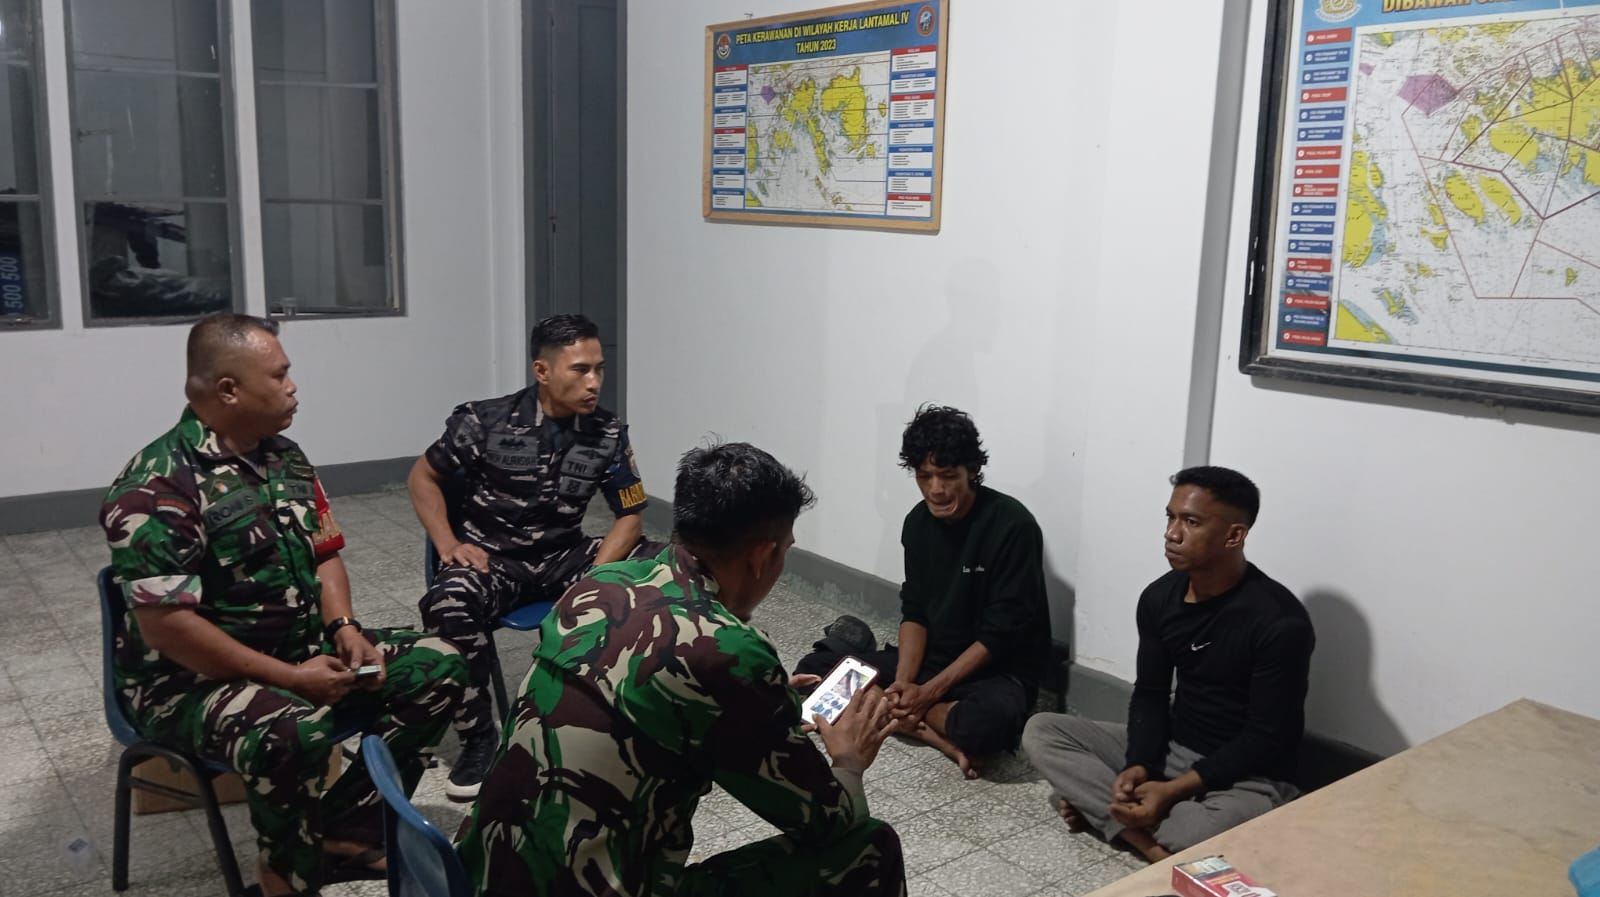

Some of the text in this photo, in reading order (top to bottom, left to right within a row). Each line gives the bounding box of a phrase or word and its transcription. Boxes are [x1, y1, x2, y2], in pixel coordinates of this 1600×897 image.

[736, 11, 910, 45] PETA KERAWANAN DI WILAYAH KERJA LANTAMAL IV
[796, 39, 836, 54] TAHUN 2023
[0, 256, 23, 308] 500 500
